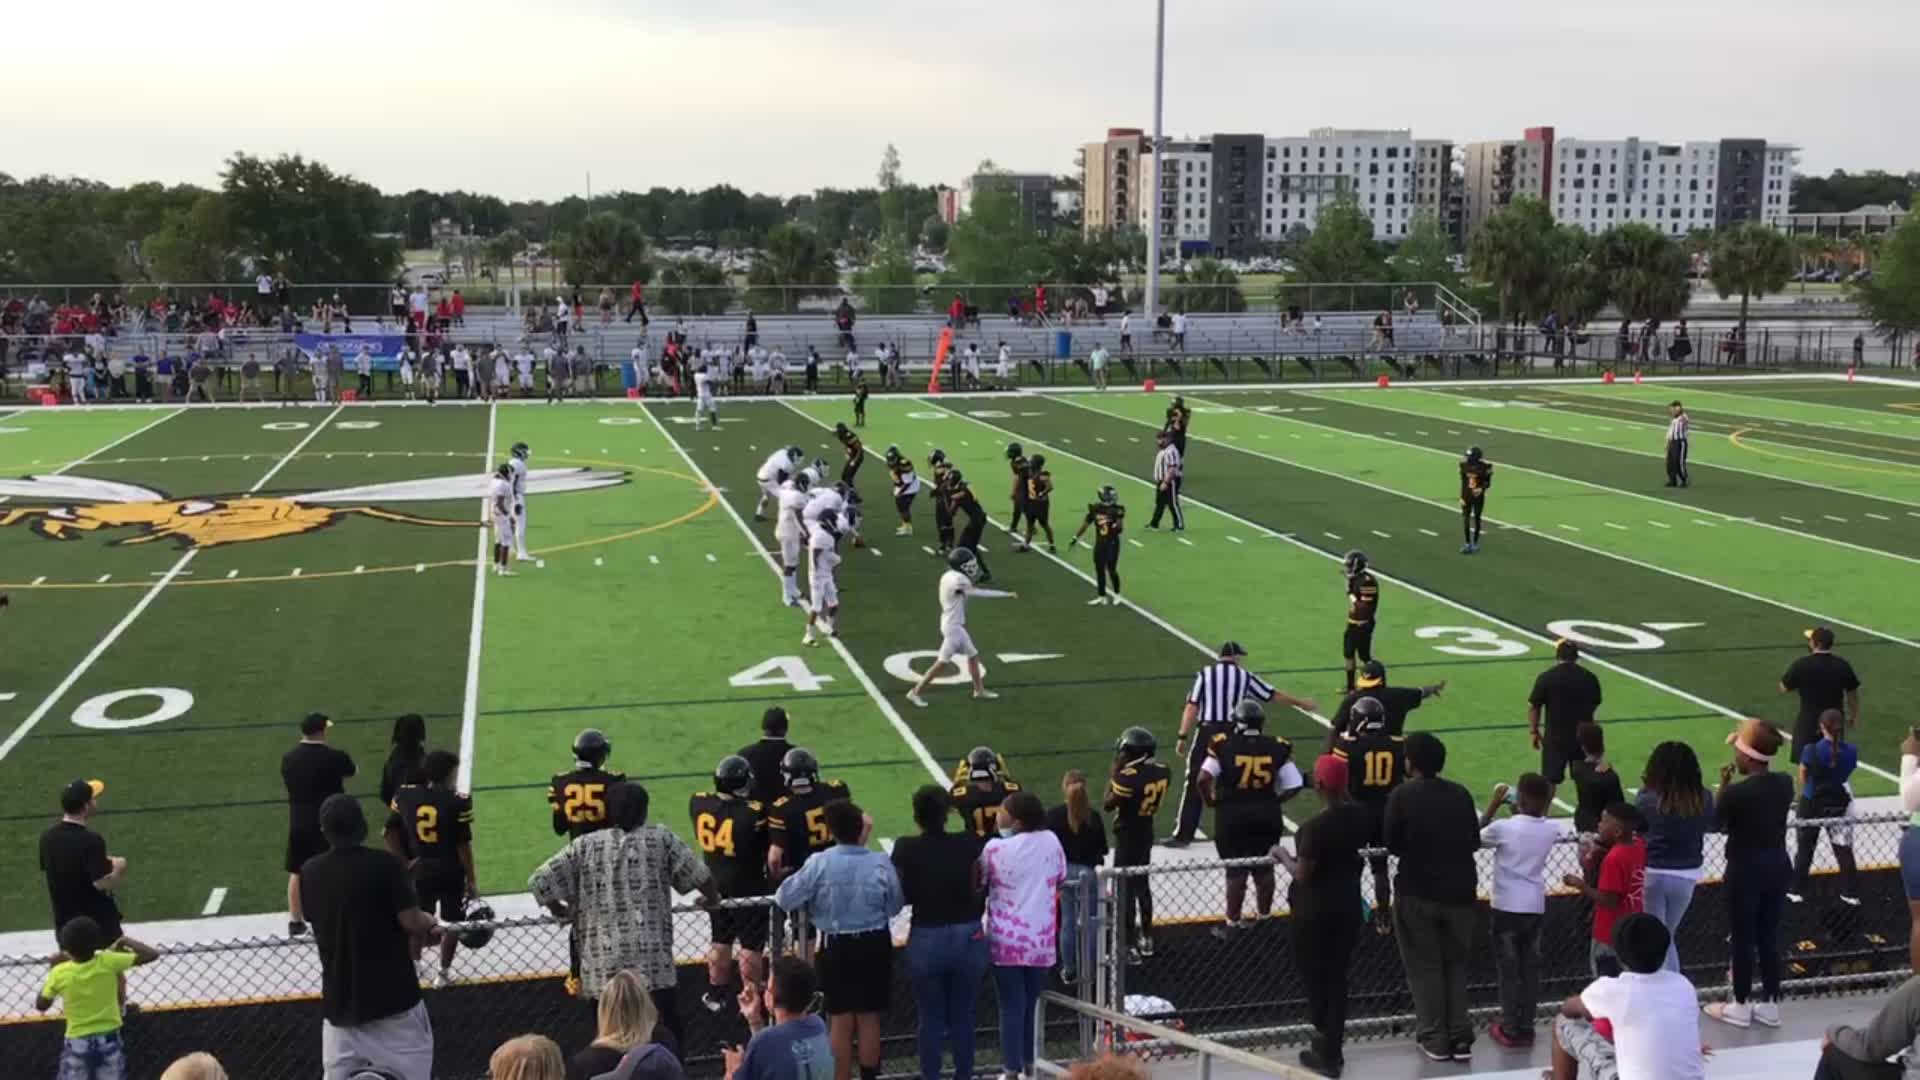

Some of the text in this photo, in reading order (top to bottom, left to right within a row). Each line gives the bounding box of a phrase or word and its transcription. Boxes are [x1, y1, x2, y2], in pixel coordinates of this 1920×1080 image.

[1234, 755, 1273, 789] 75
[1363, 751, 1393, 786] 10
[564, 783, 605, 822] 25
[1138, 778, 1168, 816] 27
[416, 804, 438, 843] 2
[697, 813, 735, 857] 64
[805, 806, 833, 847] 5
